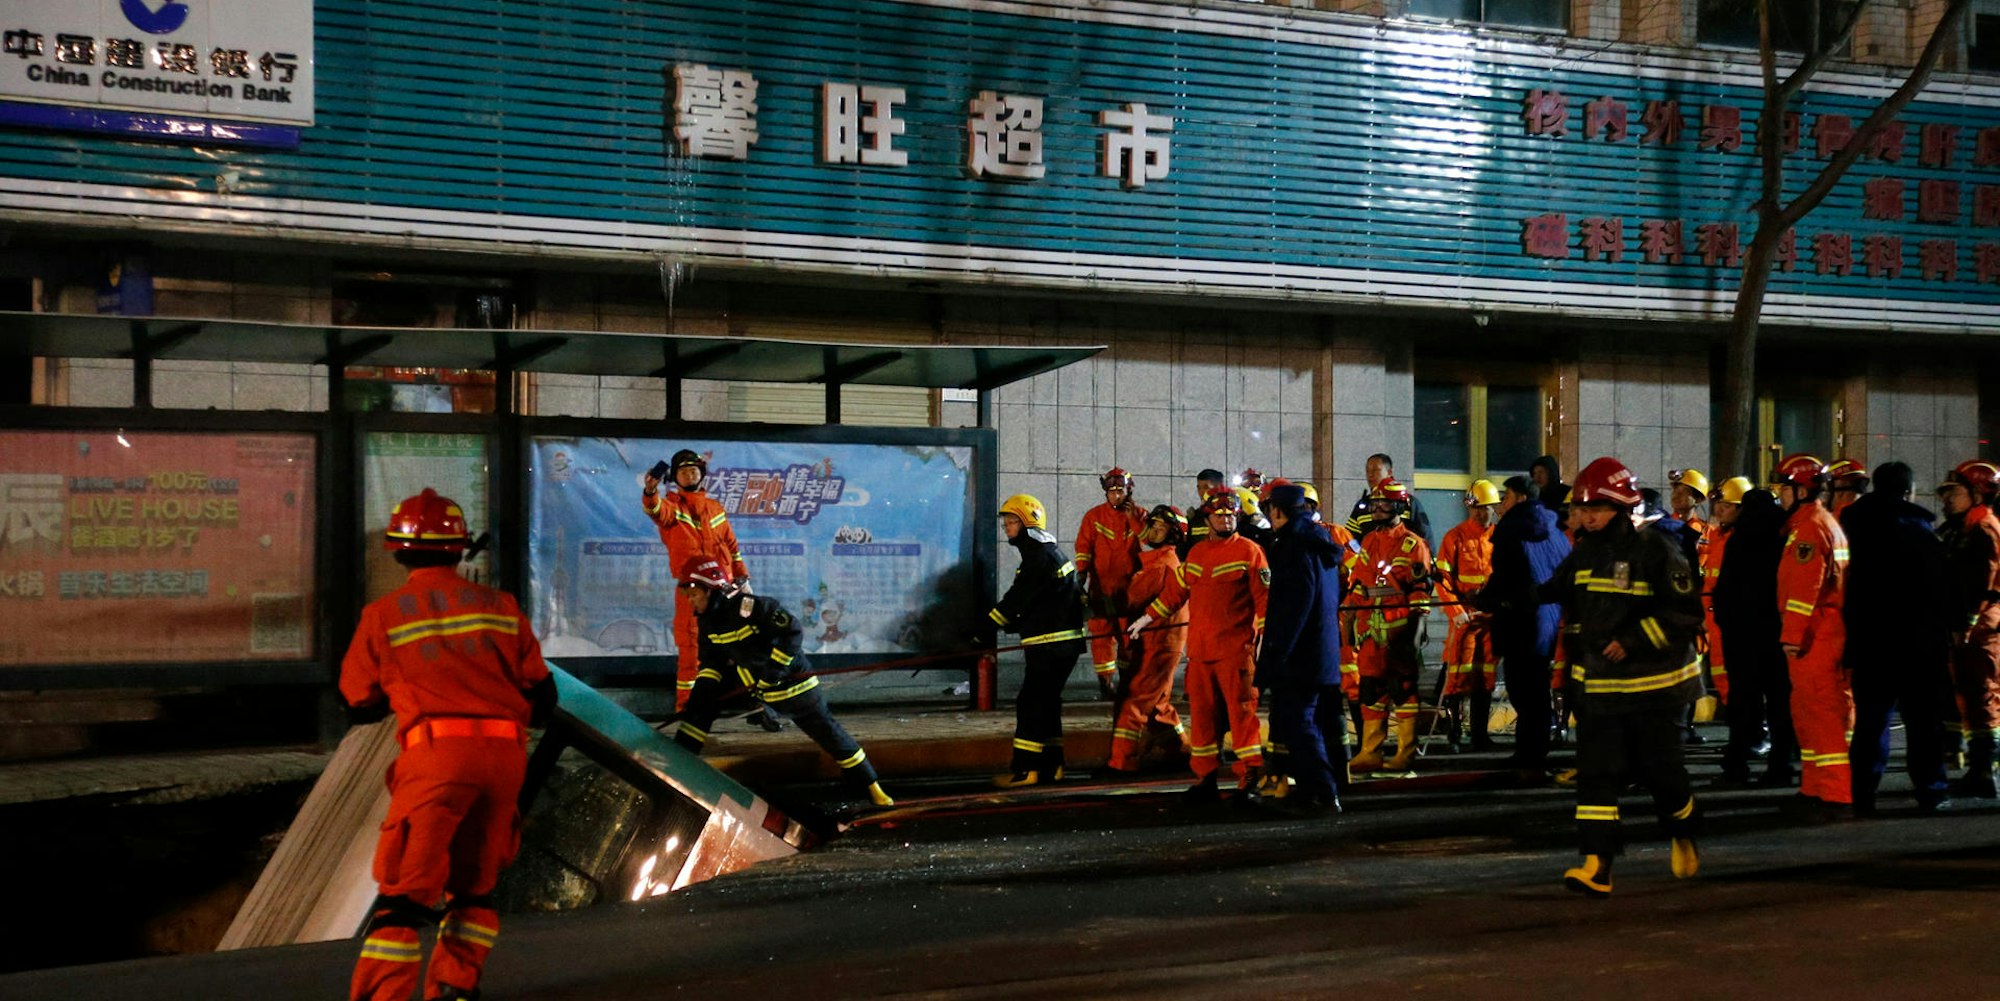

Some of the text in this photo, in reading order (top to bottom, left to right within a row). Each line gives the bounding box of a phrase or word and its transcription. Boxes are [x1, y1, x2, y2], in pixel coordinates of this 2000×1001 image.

[3, 28, 298, 83] 中国建设银行
[26, 64, 292, 104] China Construction Bank
[672, 63, 1174, 188] 馨旺超市
[71, 497, 239, 520] LIVE HOUSE
[59, 569, 209, 599] 音乐生活空间
